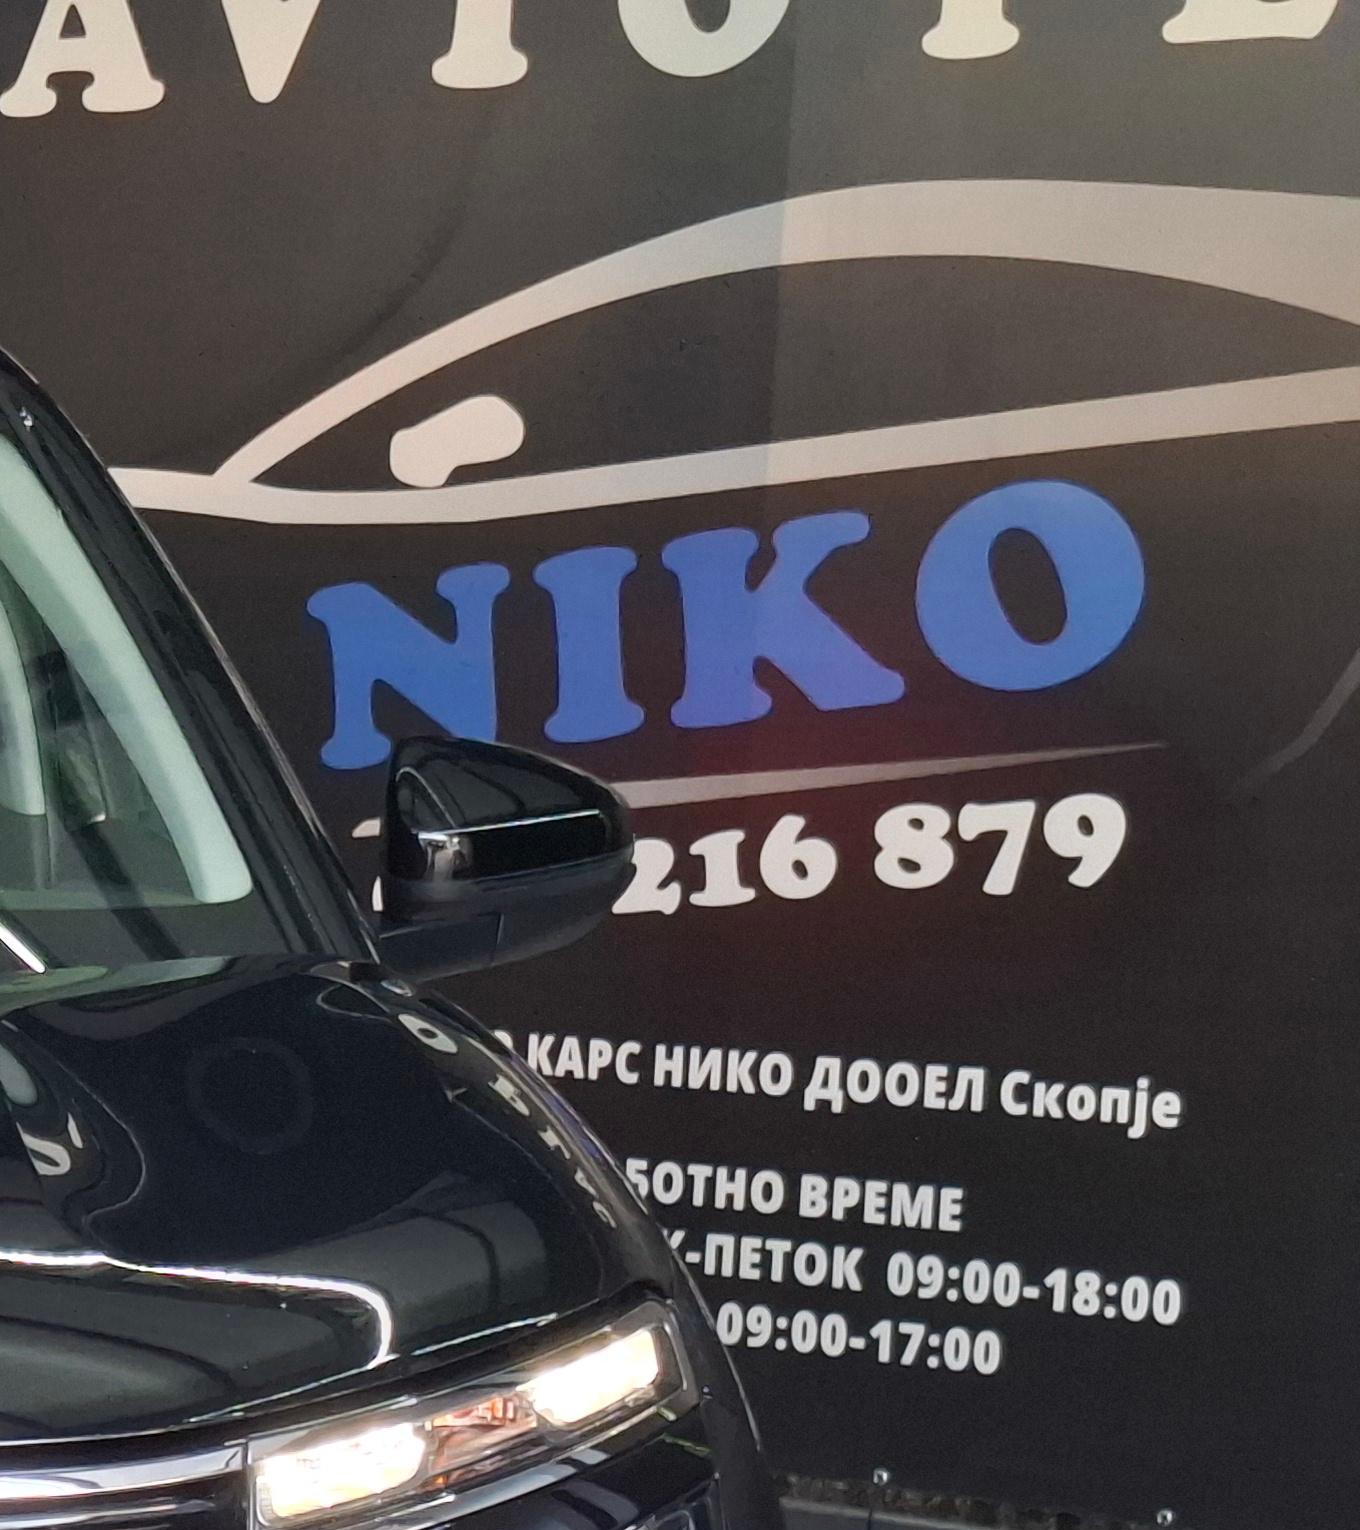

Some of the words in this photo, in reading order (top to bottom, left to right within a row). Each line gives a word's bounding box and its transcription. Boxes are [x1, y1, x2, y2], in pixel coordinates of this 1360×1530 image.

[306, 479, 1147, 770] NIKO
[611, 813, 838, 915] 216
[873, 793, 1127, 896] 879
[526, 1032, 642, 1085] КАРС
[653, 1043, 795, 1097] НИКО
[803, 1055, 987, 1114] ДООЕЛ
[999, 1069, 1183, 1140] Скопје
[798, 1173, 965, 1232] ВРЕМЕ
[885, 1250, 1183, 1327] 09:00-18:00
[716, 1301, 1003, 1376] 09:00-17:00
